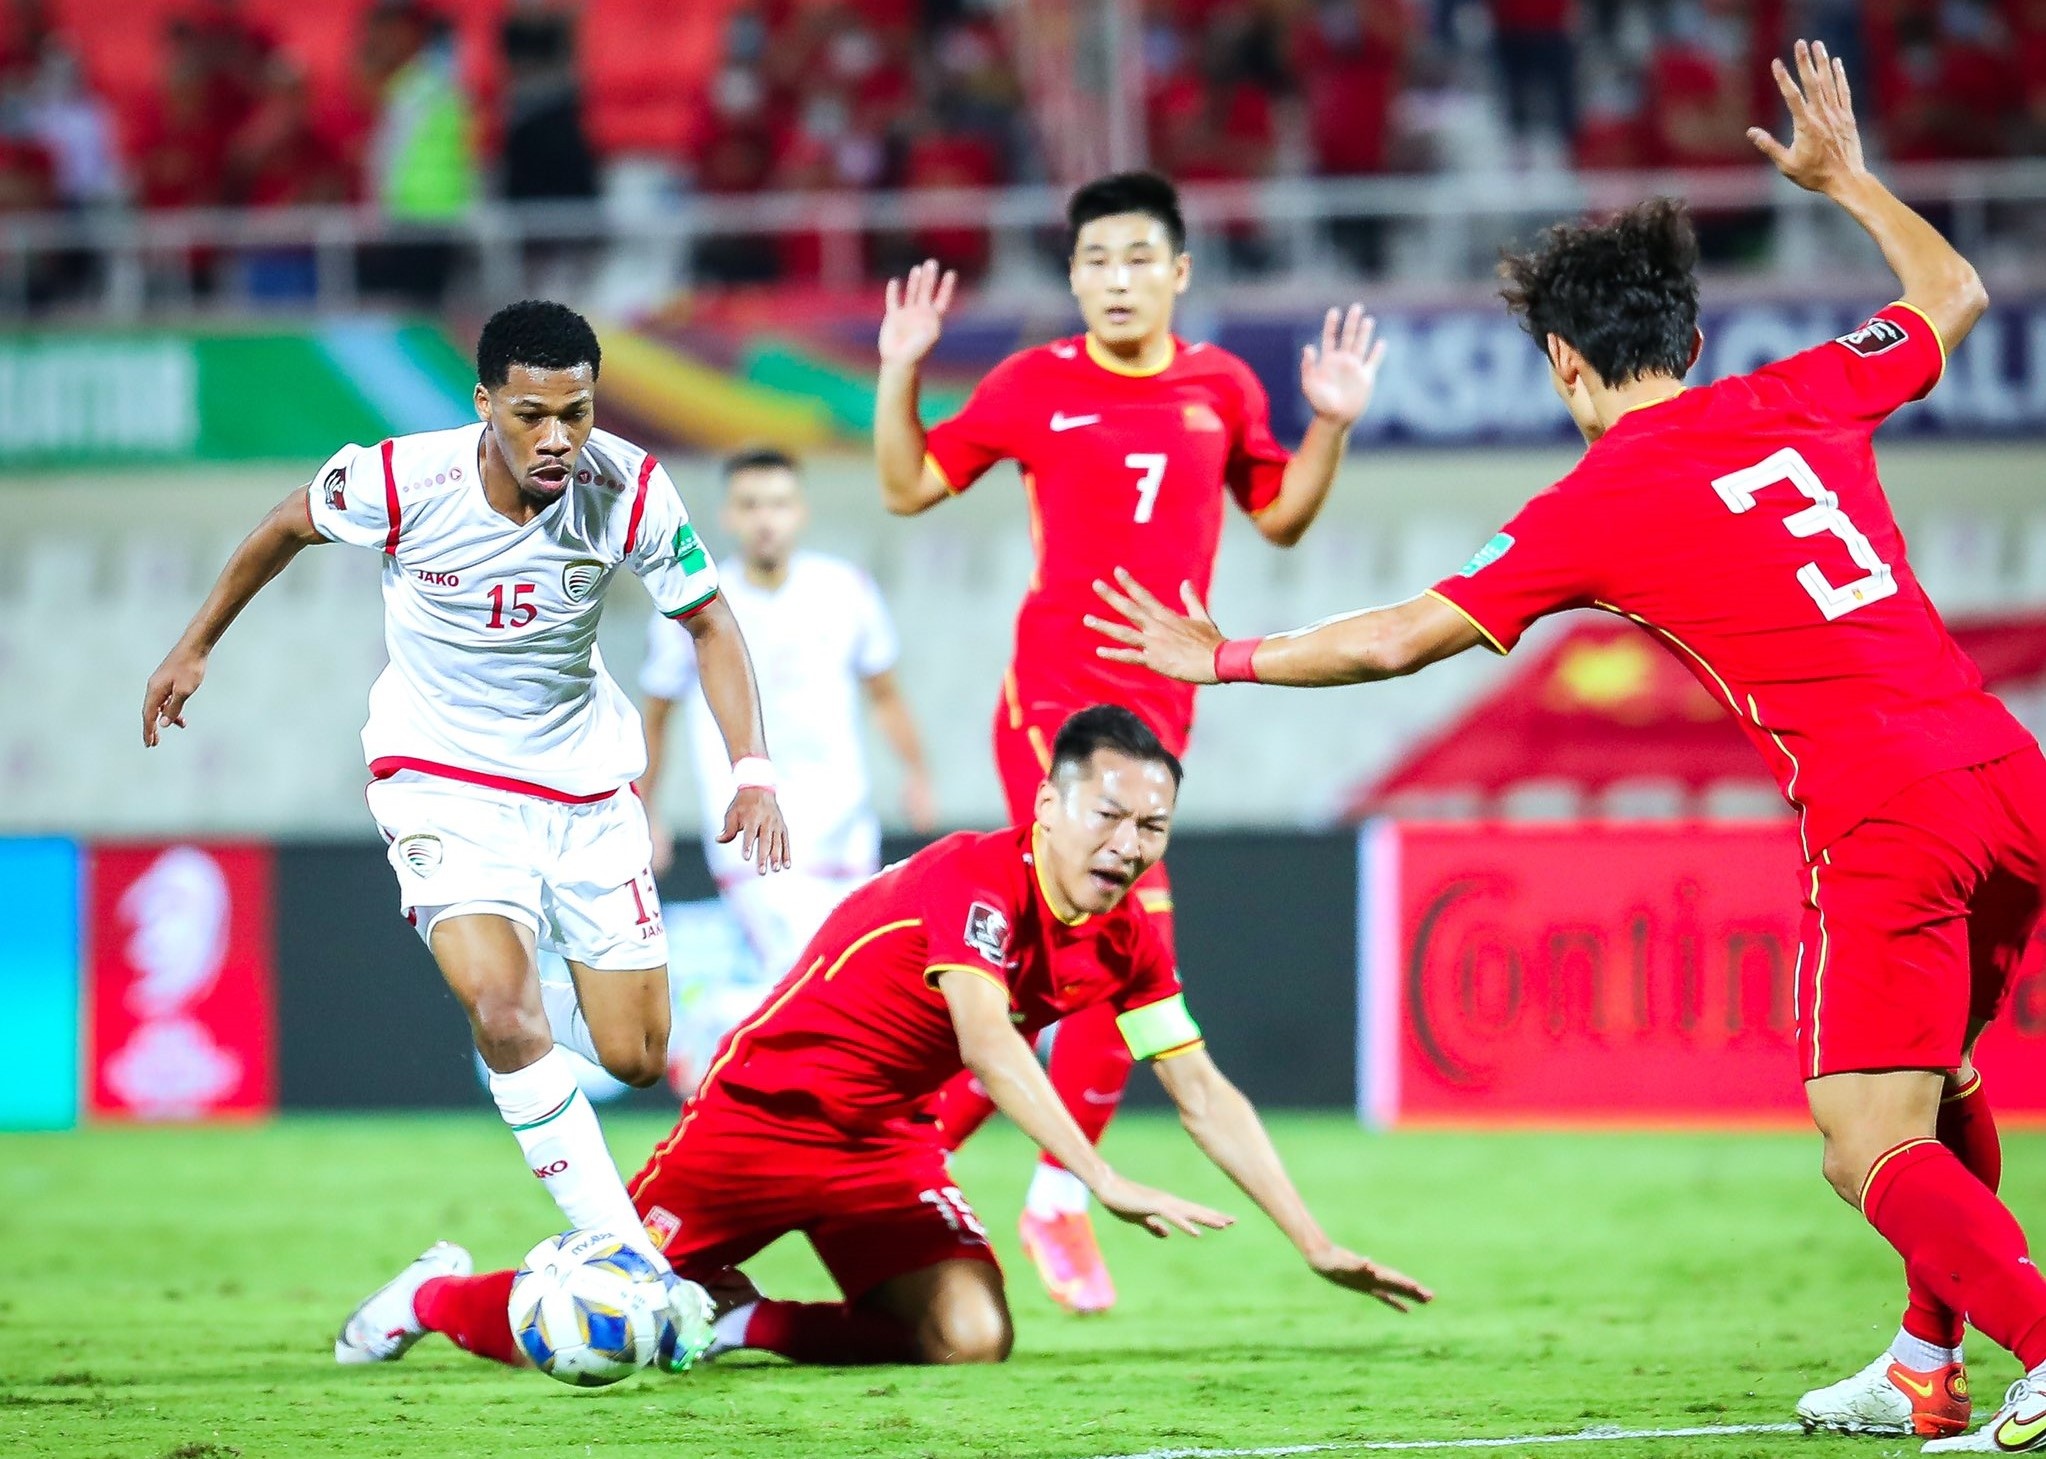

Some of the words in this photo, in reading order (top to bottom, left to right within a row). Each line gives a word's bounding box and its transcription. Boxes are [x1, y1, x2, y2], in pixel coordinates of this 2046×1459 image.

[1124, 453, 1168, 524] 7
[1710, 446, 1899, 622] 3
[417, 569, 460, 588] JAKO
[485, 583, 538, 629] 15
